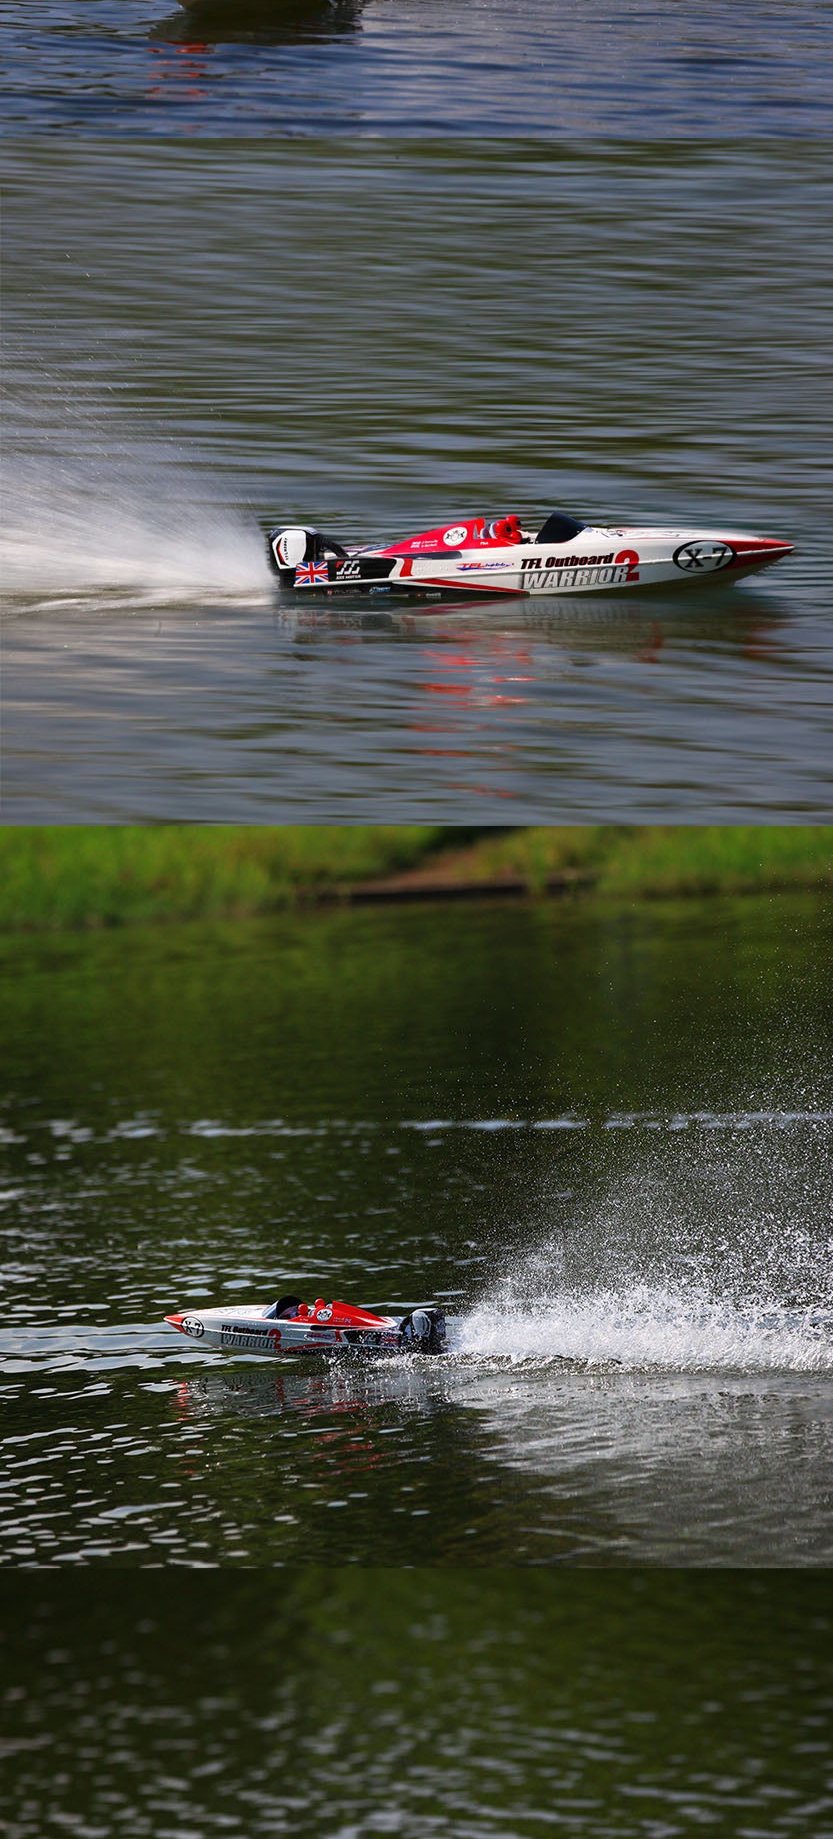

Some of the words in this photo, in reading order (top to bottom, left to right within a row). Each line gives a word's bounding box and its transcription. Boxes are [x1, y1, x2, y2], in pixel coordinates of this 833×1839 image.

[520, 558, 542, 570] TFL
[546, 552, 615, 568] Outboard
[684, 546, 728, 569] X-7
[522, 565, 628, 590] WARRIOR
[614, 549, 640, 582] 2
[221, 1324, 233, 1333] TFL
[221, 1333, 277, 1350] WARRIOR
[268, 1328, 282, 1350] 2
